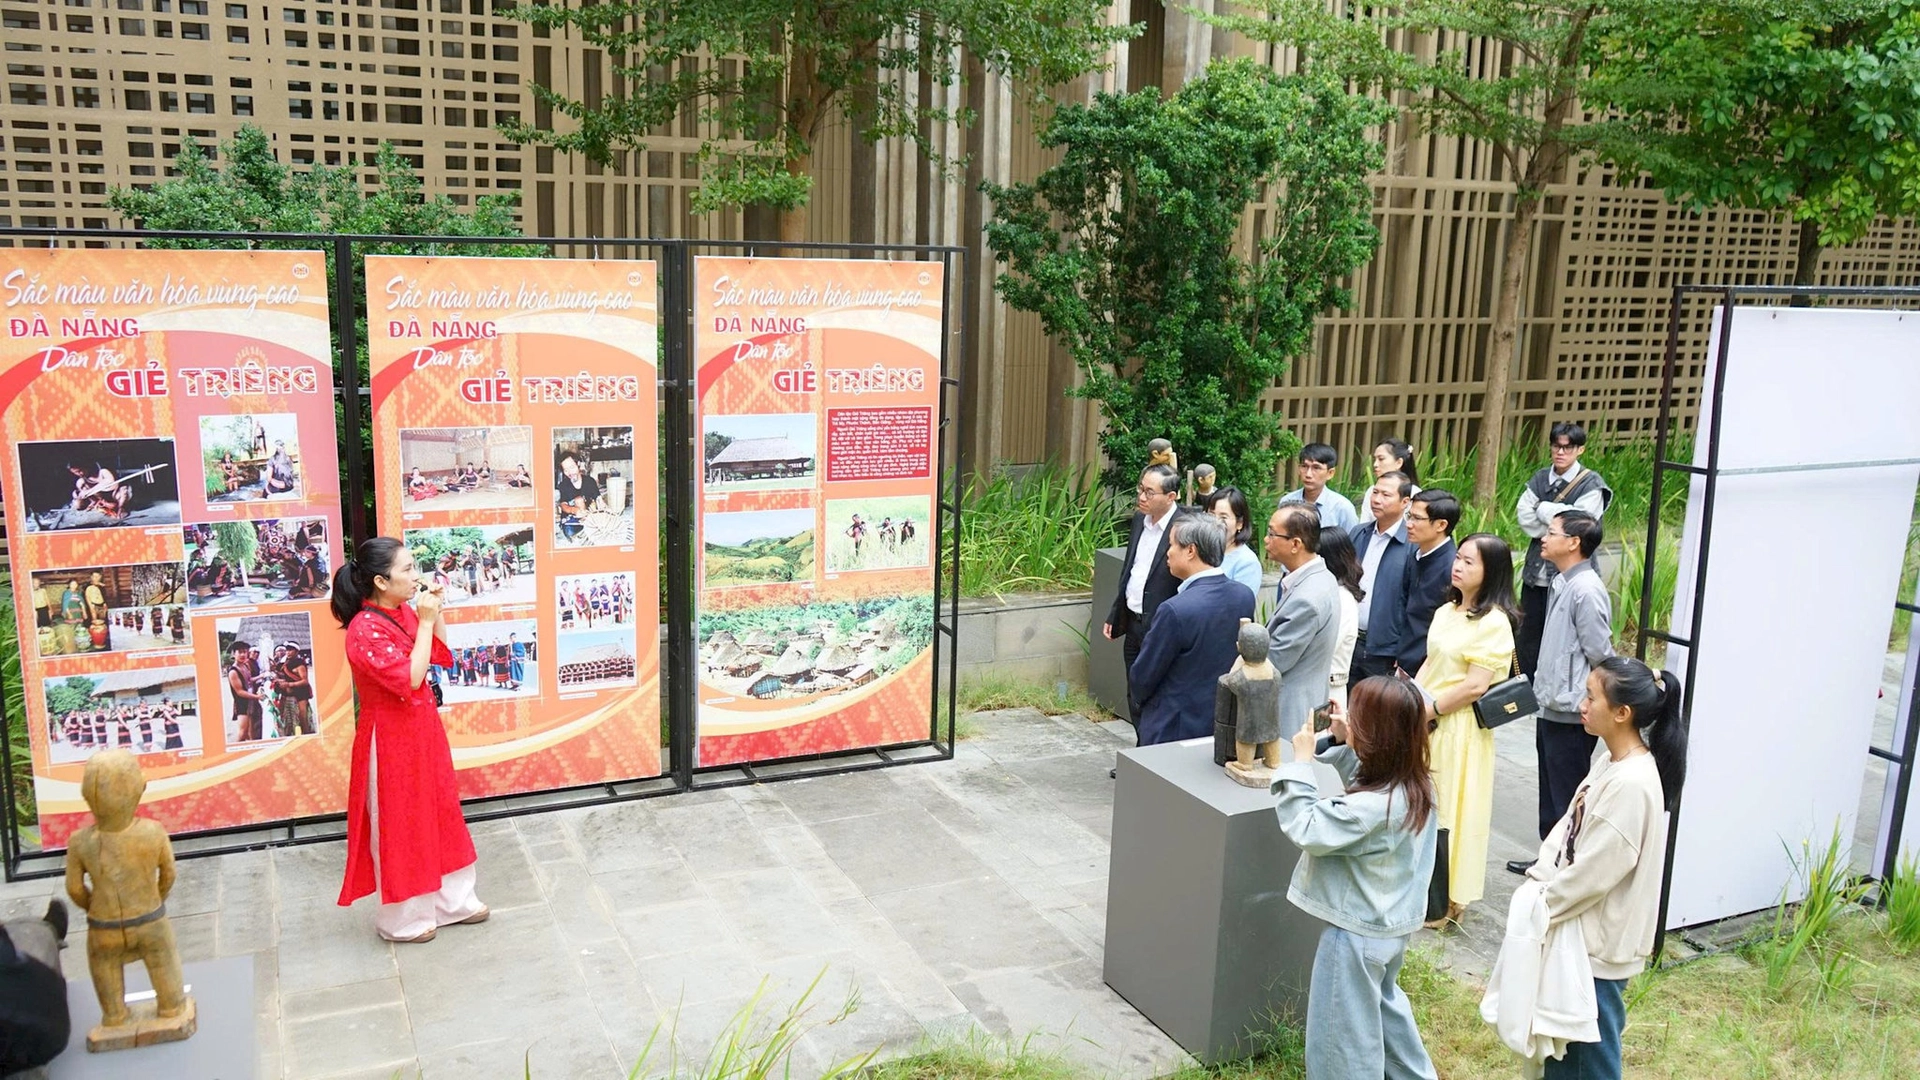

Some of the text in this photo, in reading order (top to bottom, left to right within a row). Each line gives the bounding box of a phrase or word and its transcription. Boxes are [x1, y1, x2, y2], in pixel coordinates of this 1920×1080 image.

[3, 269, 51, 307] Sắc
[55, 275, 107, 304] màu
[113, 279, 155, 304] văn
[160, 272, 203, 305] hóa
[265, 285, 300, 305] cao
[386, 275, 422, 311] Sắc
[427, 282, 471, 309] màu
[476, 285, 510, 309] văn
[602, 291, 633, 311] cao
[9, 309, 141, 338] ĐÀ NẴNG
[388, 314, 421, 338] ĐÀ
[714, 313, 742, 333] ĐÀ
[38, 345, 88, 372] Dân
[104, 360, 318, 397] GIẺ TRIÊNG
[459, 370, 639, 405] GIẺ TRIÊNG
